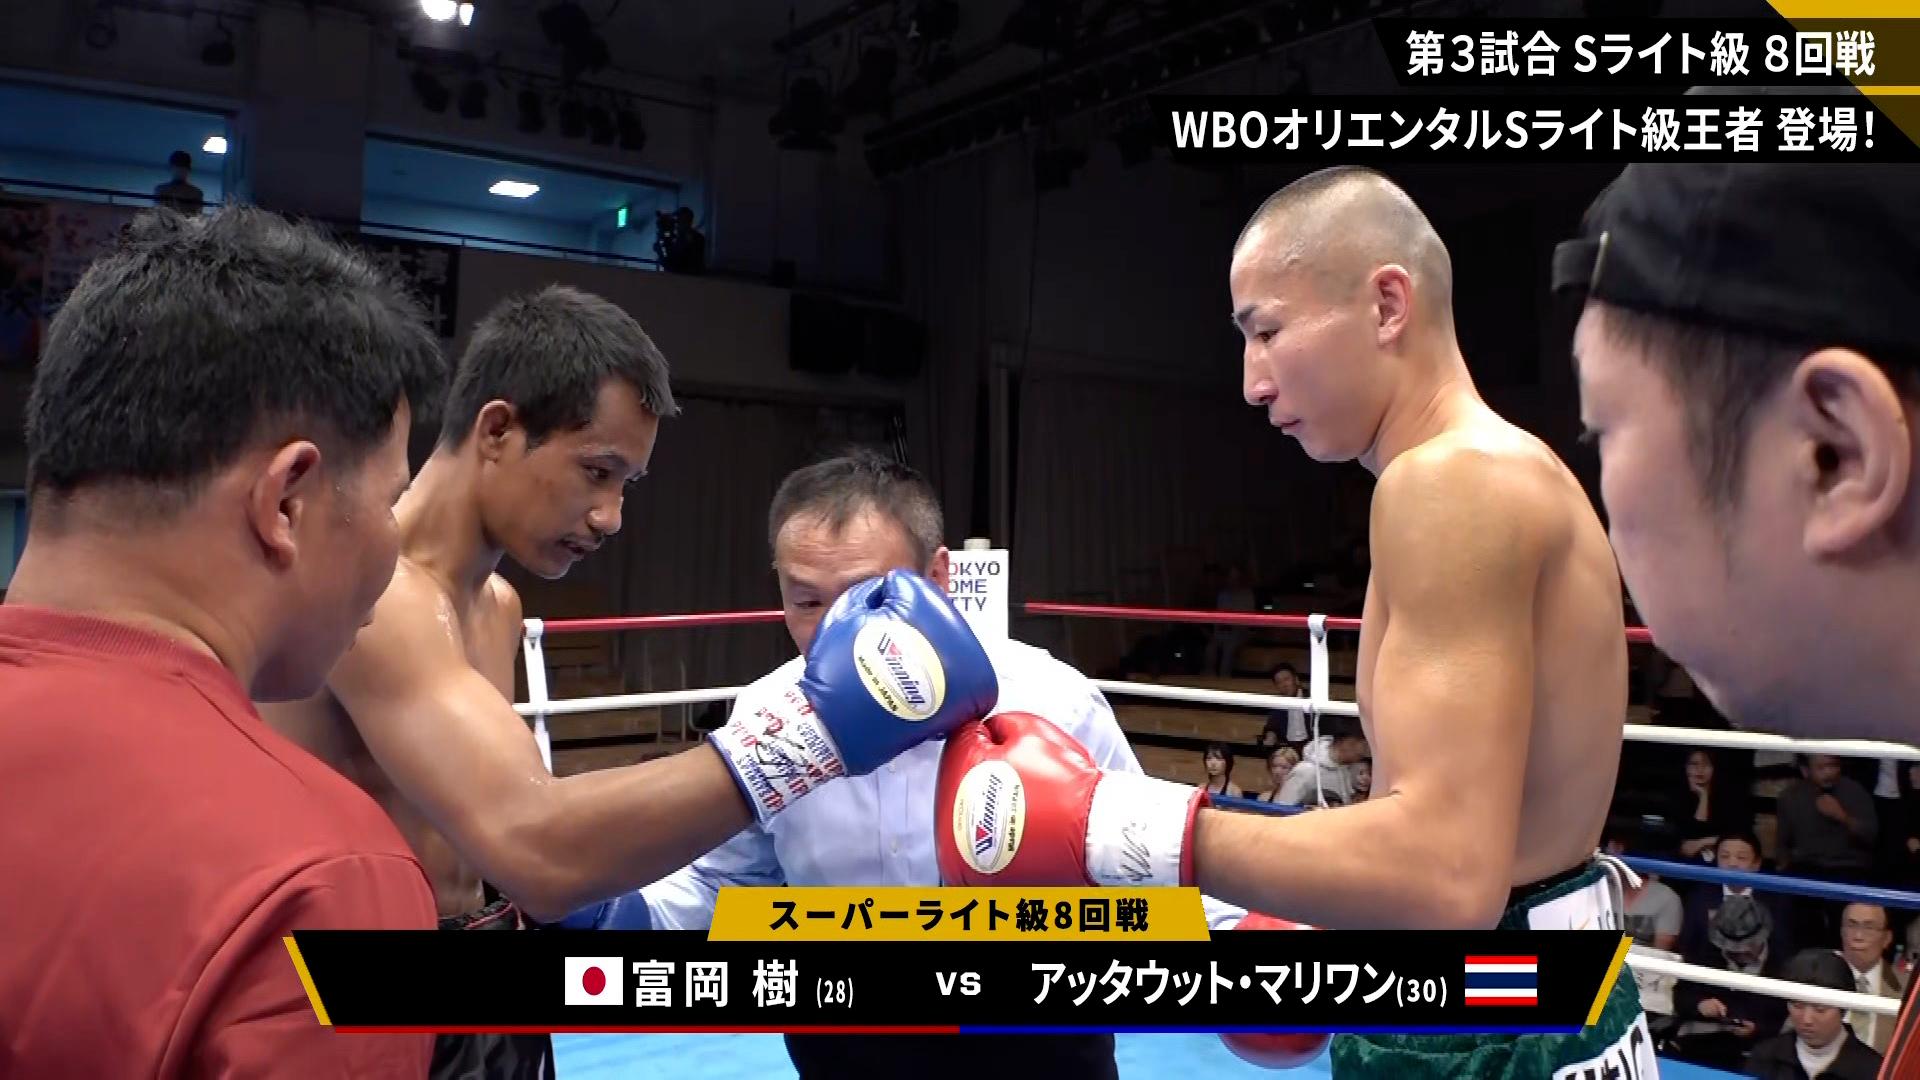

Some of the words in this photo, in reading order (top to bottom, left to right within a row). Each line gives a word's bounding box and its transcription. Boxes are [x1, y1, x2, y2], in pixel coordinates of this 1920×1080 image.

[948, 561, 1000, 575] OKYO
[948, 579, 987, 593] OME
[948, 597, 987, 611] TY
[878, 633, 925, 706] Winning
[879, 687, 899, 712] JAPAN
[976, 774, 1002, 856] Winning
[1008, 827, 1016, 852] Made
